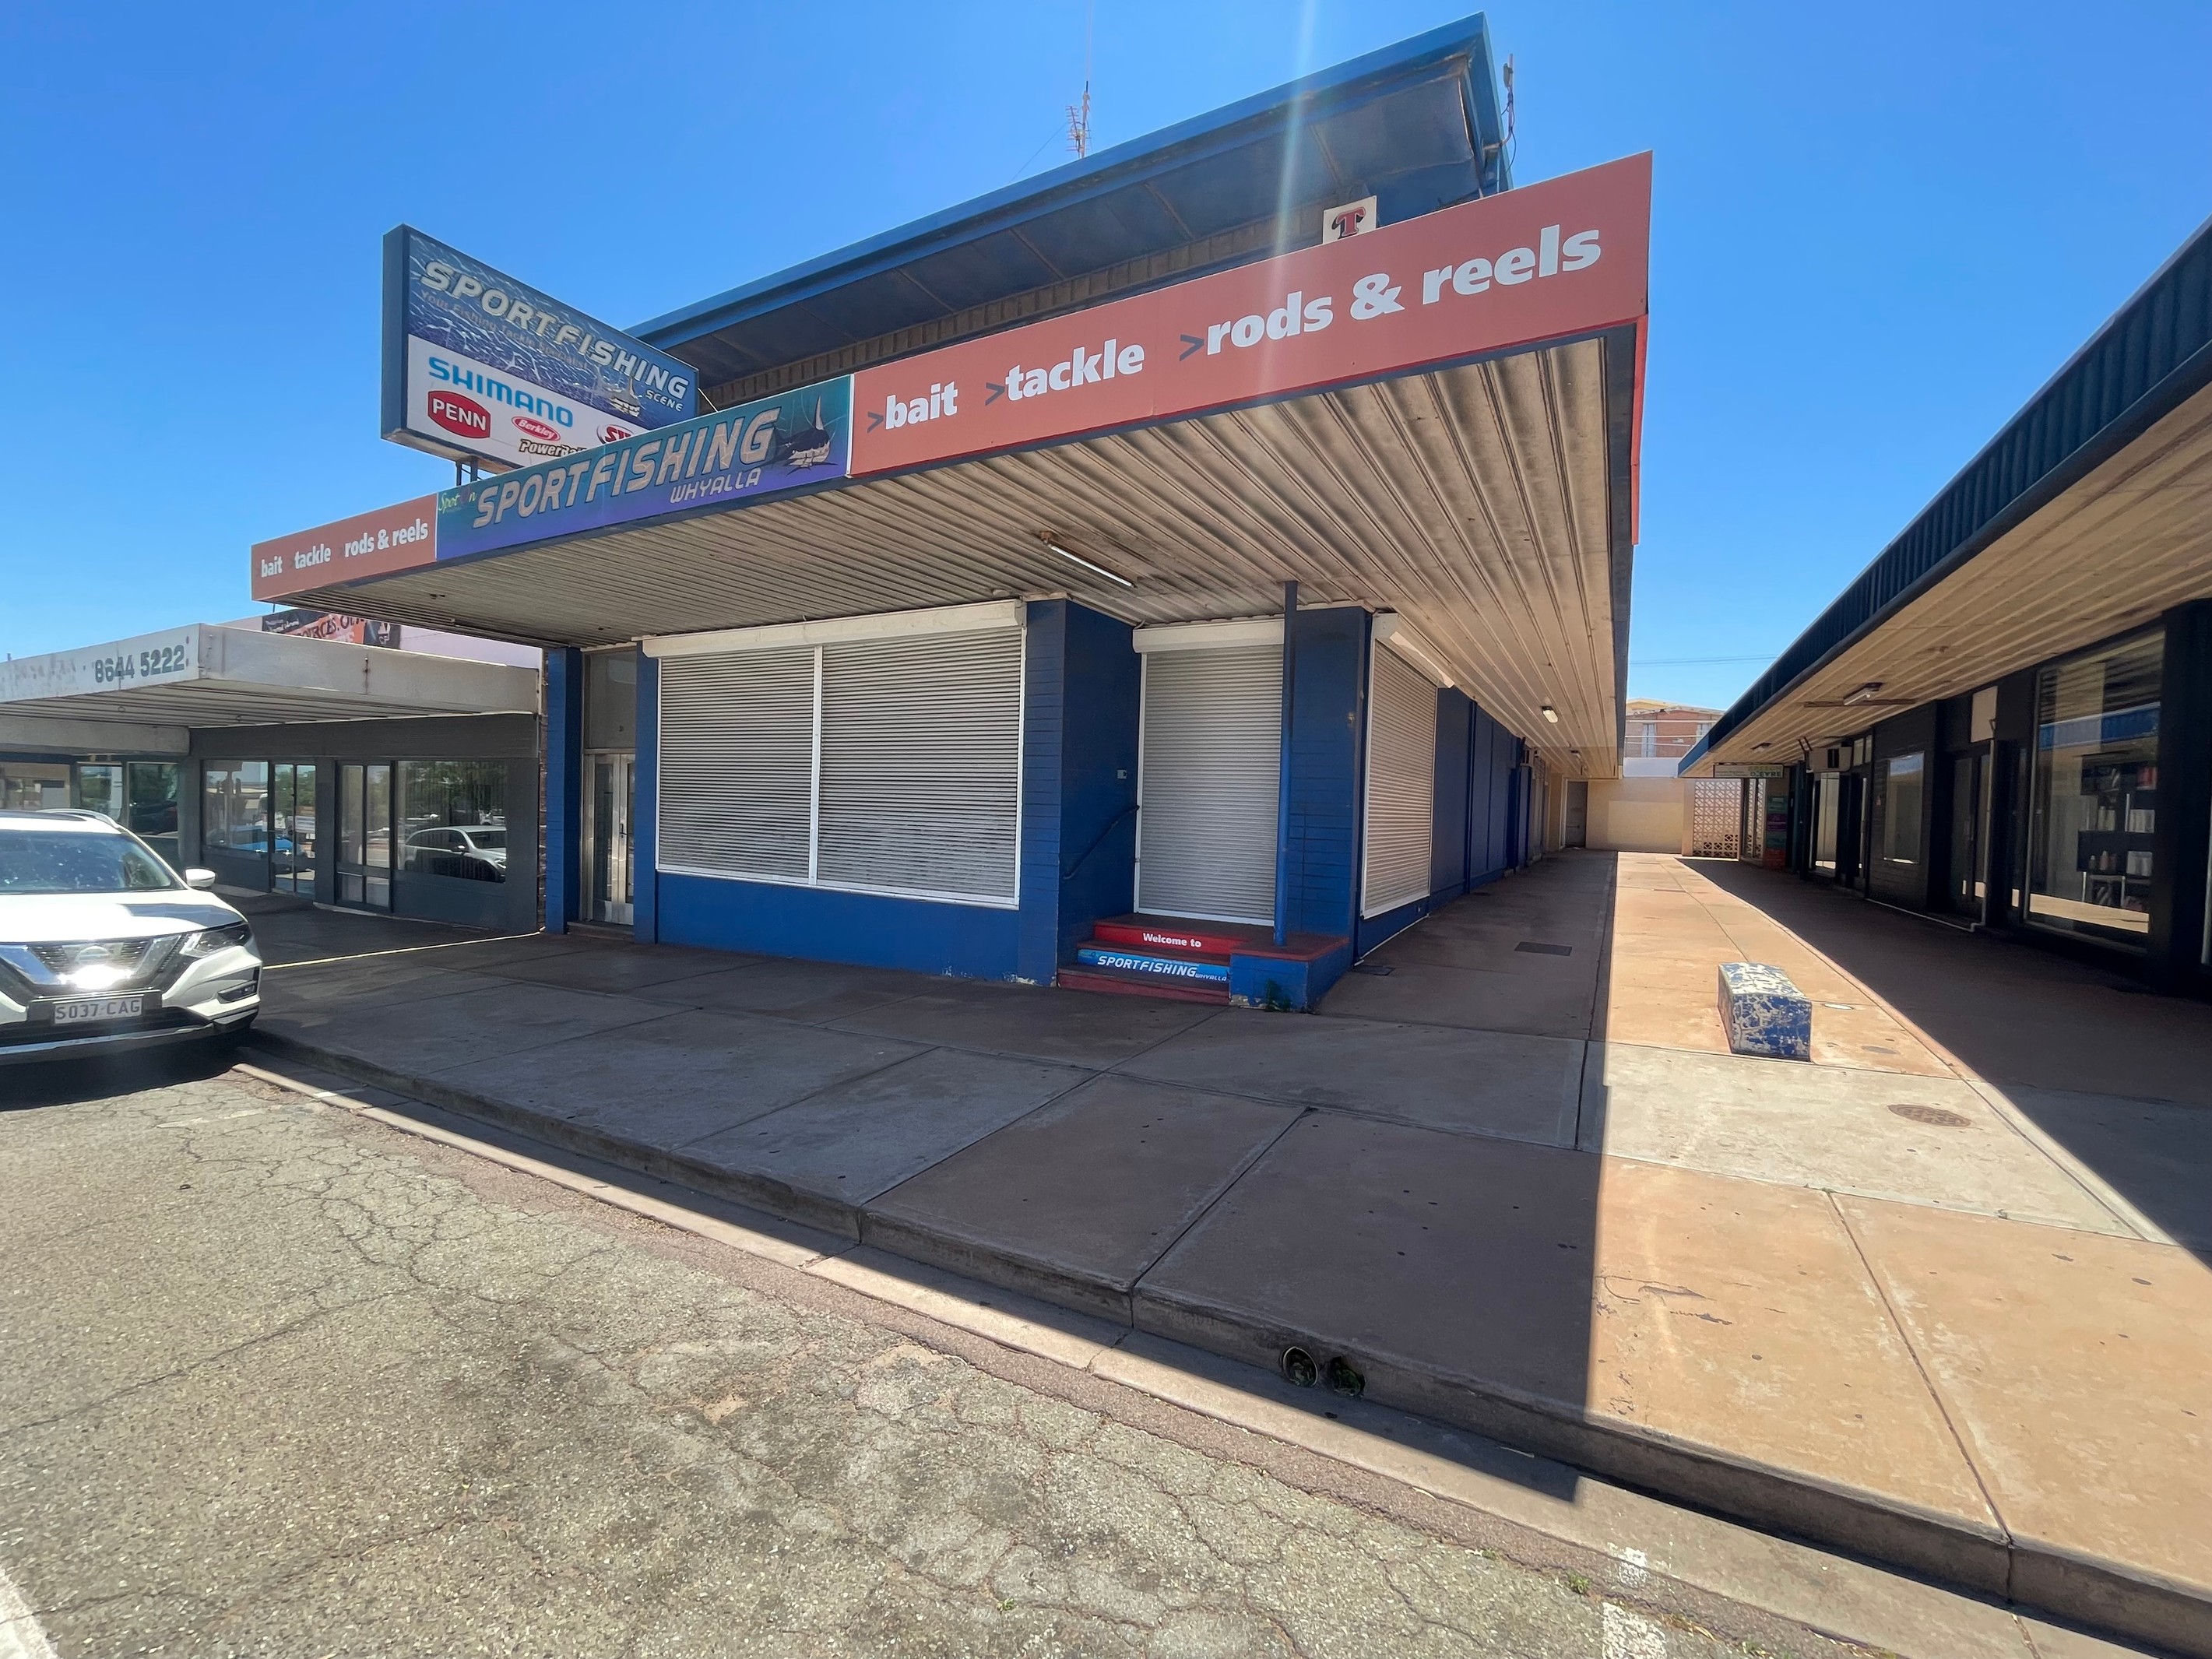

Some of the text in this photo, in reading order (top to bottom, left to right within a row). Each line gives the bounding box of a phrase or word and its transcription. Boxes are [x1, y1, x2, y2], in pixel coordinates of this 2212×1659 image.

[1331, 206, 1366, 240] T
[420, 260, 690, 400] SPORTFISHING
[884, 223, 1602, 430] bait tackle rods & reels
[428, 356, 573, 428] SHIMANO
[645, 389, 684, 412] SCENE
[433, 398, 486, 431] PENN
[518, 417, 556, 441] Berkley
[472, 407, 781, 529] SPORTFISHING
[669, 467, 761, 504] WHYALLA
[261, 518, 429, 578] bait tackle rods & reels
[94, 656, 135, 684] 8644
[140, 644, 185, 677] 5222
[1143, 933, 1202, 948] Welcome to
[1097, 955, 1197, 978] SPORTFISHING
